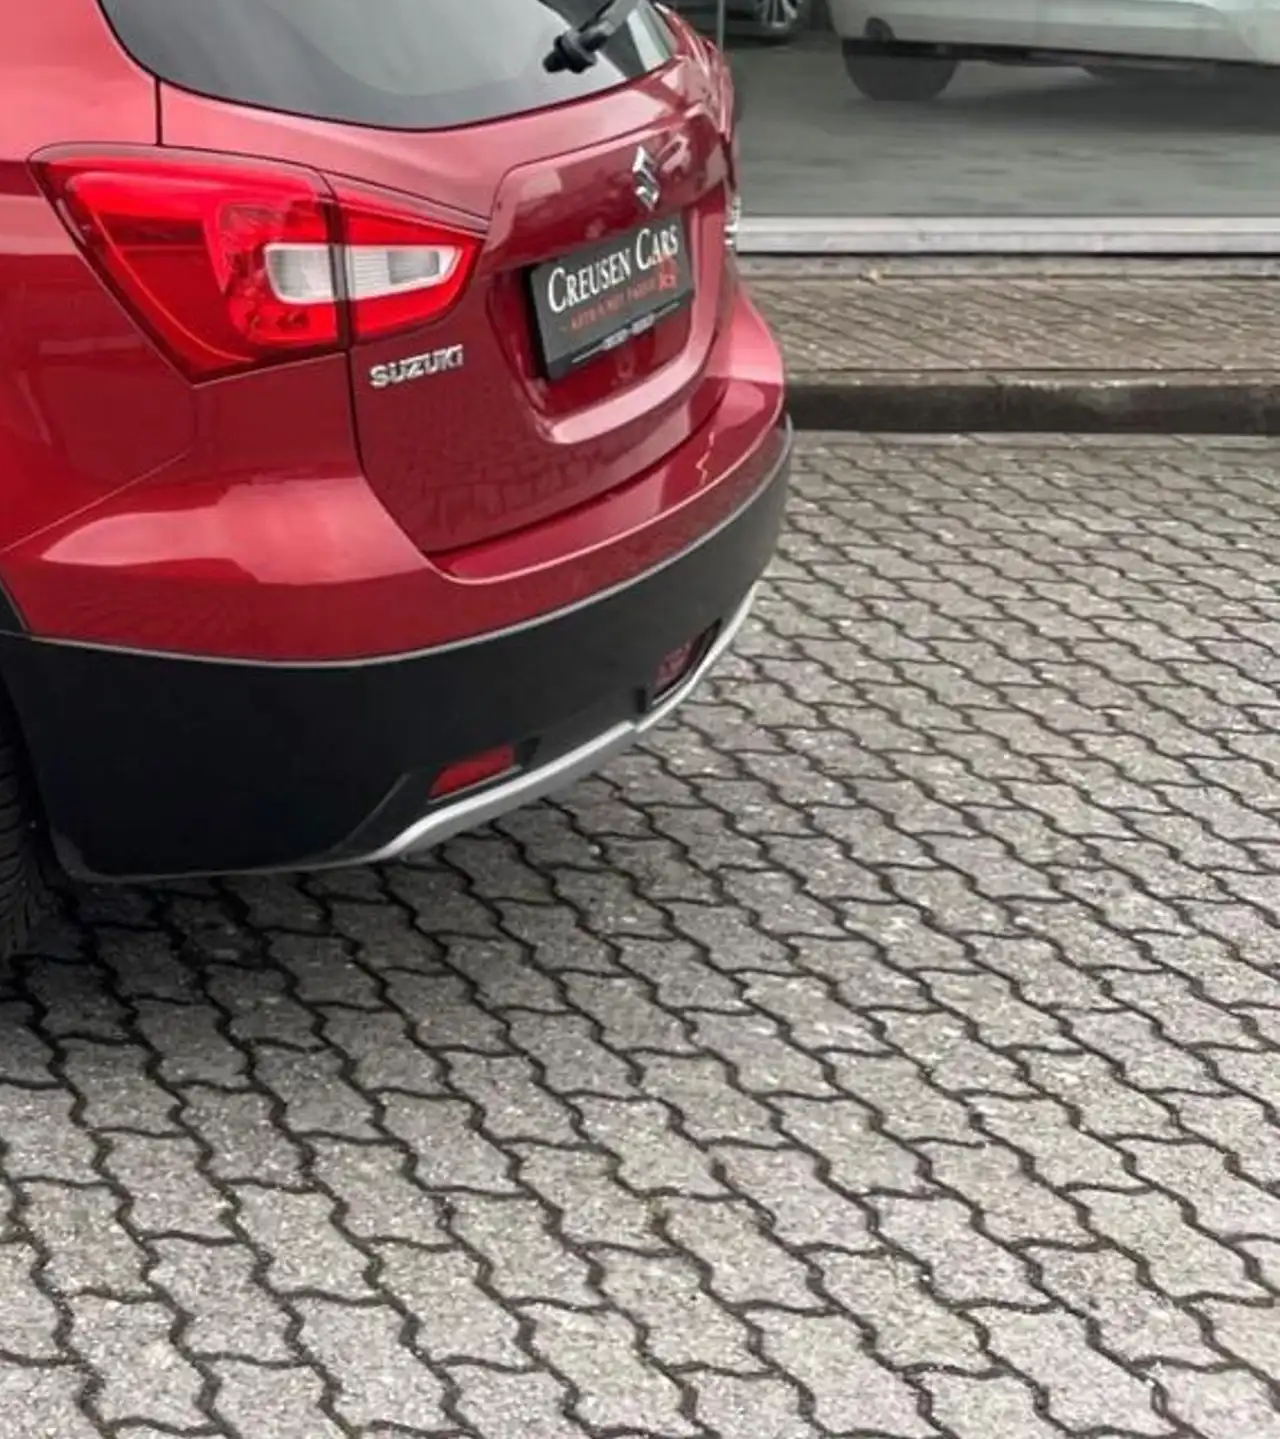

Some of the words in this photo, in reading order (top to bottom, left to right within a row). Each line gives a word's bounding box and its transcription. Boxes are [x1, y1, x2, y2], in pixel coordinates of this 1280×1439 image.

[546, 247, 632, 315] CREUSEN
[635, 223, 680, 271] CARS
[368, 343, 465, 388] SUZUKI
